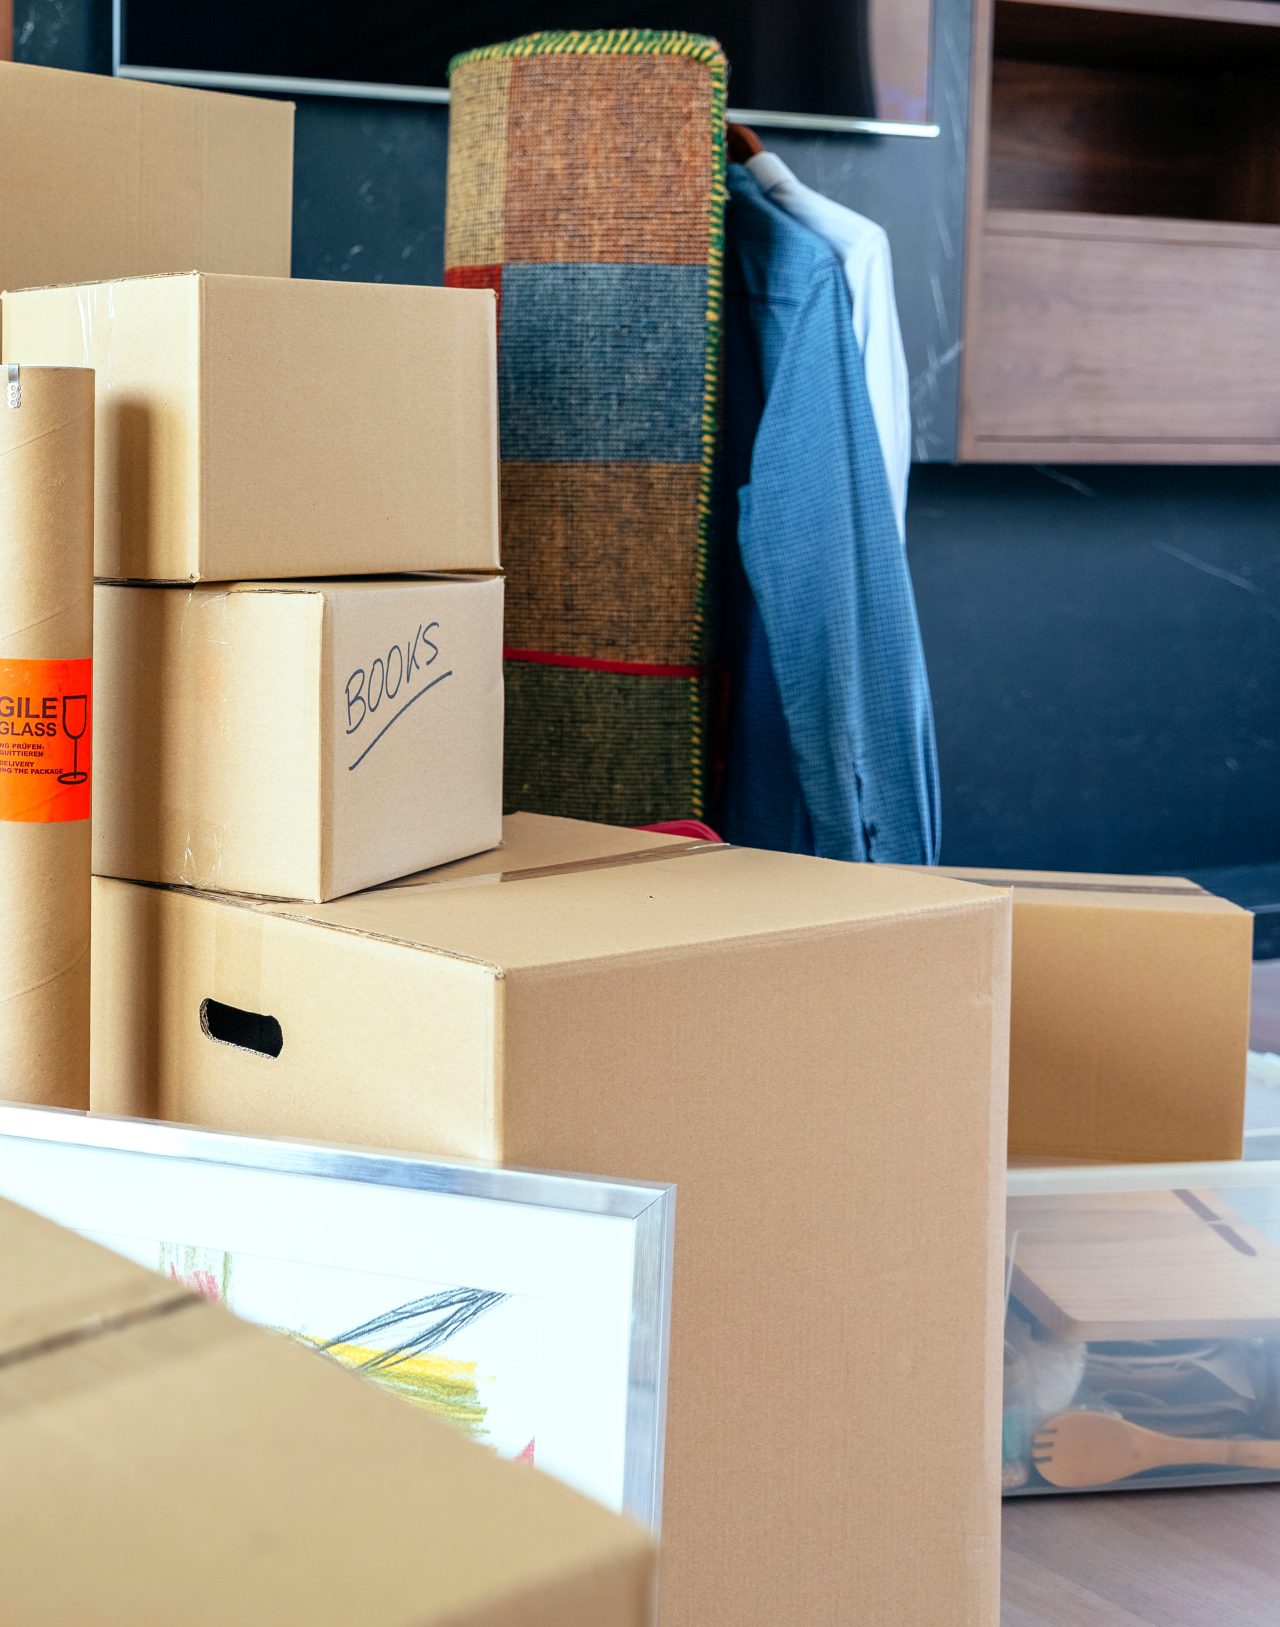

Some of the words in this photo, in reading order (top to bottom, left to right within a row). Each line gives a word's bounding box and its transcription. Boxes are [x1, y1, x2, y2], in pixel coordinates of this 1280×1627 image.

[345, 621, 440, 735] BOOKS
[0, 749, 44, 757] QUITTIEREN
[0, 759, 35, 767] DELIVERY
[30, 767, 63, 775] PACKAGE
